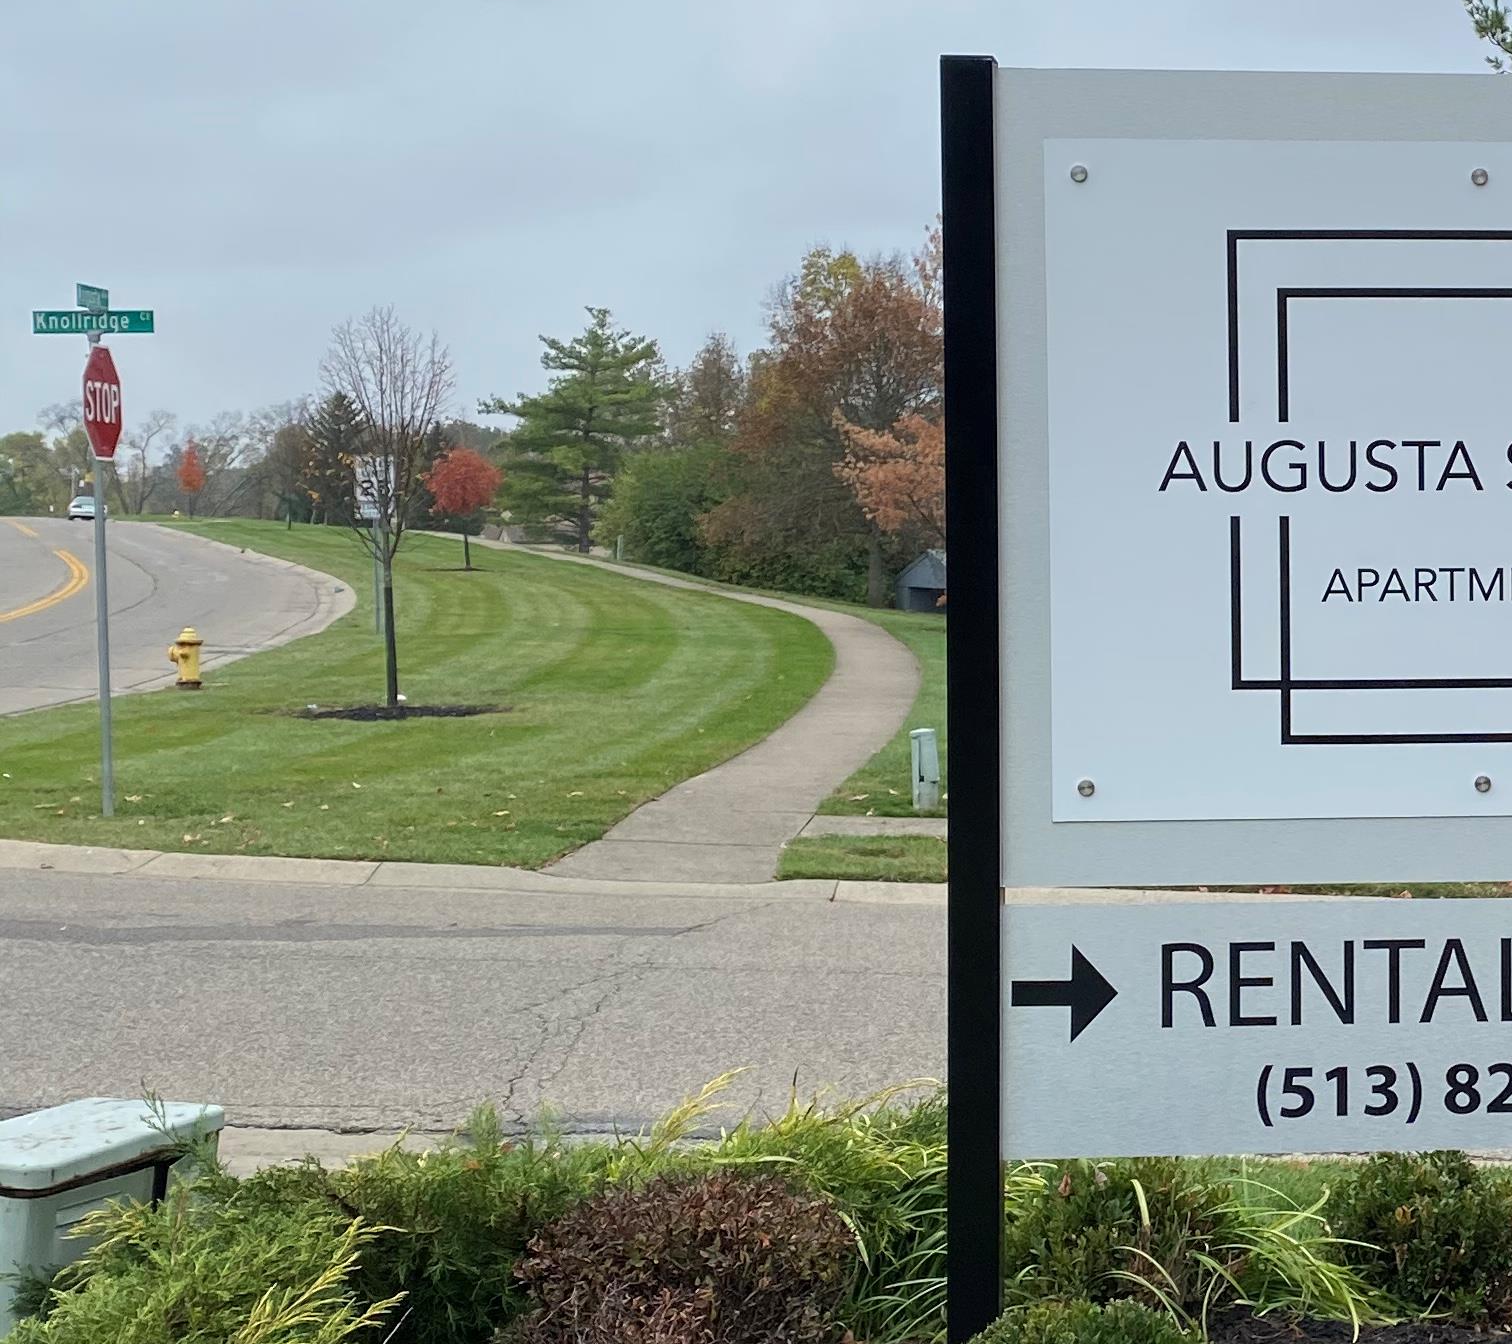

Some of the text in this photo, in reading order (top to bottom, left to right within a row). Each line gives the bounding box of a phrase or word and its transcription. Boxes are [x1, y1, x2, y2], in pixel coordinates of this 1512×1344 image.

[36, 312, 129, 332] Knollridge
[85, 380, 119, 424] STOP
[1159, 440, 1483, 492] AUGUSTA
[1257, 1062, 1423, 1127] (513)
